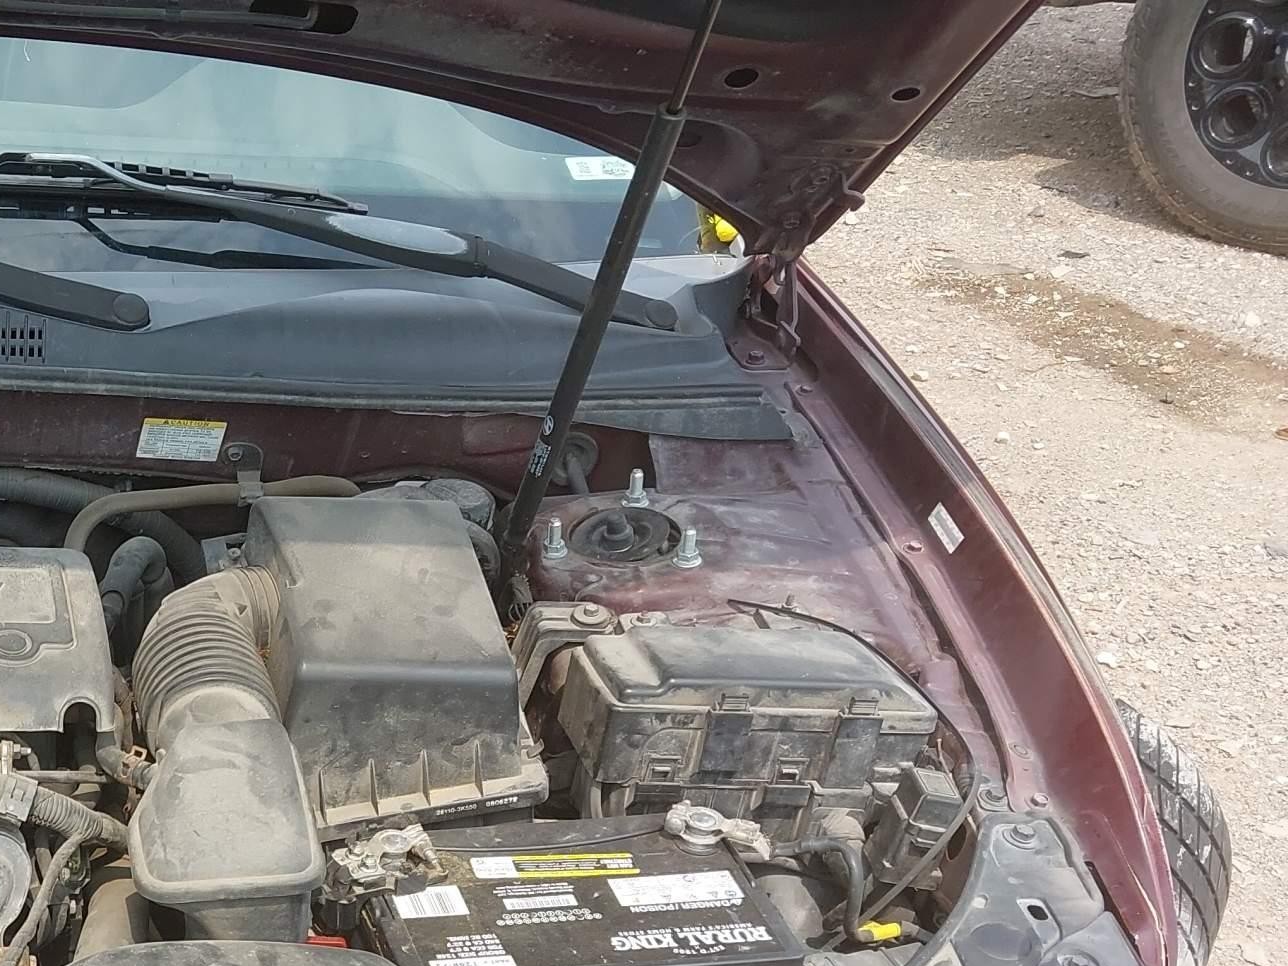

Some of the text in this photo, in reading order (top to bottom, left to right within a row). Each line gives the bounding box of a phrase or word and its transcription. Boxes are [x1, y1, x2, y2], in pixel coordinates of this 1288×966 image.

[681, 899, 731, 910] DANGER
[610, 926, 773, 951] RURAL KING
